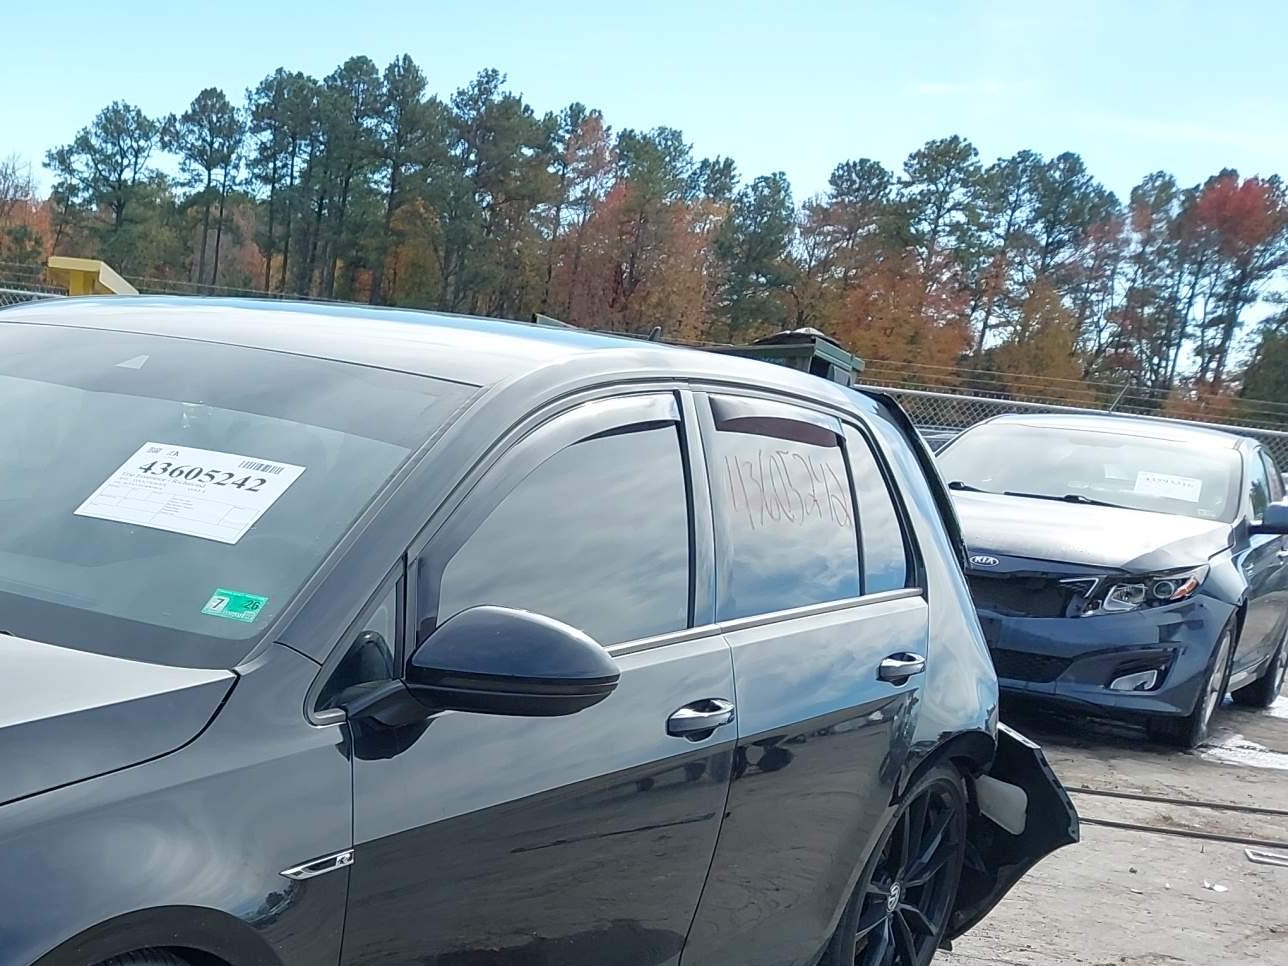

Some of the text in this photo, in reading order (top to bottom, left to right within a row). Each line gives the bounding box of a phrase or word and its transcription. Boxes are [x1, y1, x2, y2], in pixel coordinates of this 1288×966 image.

[138, 460, 267, 492] 43605242
[972, 556, 996, 566] KIA
[213, 598, 225, 608] 7
